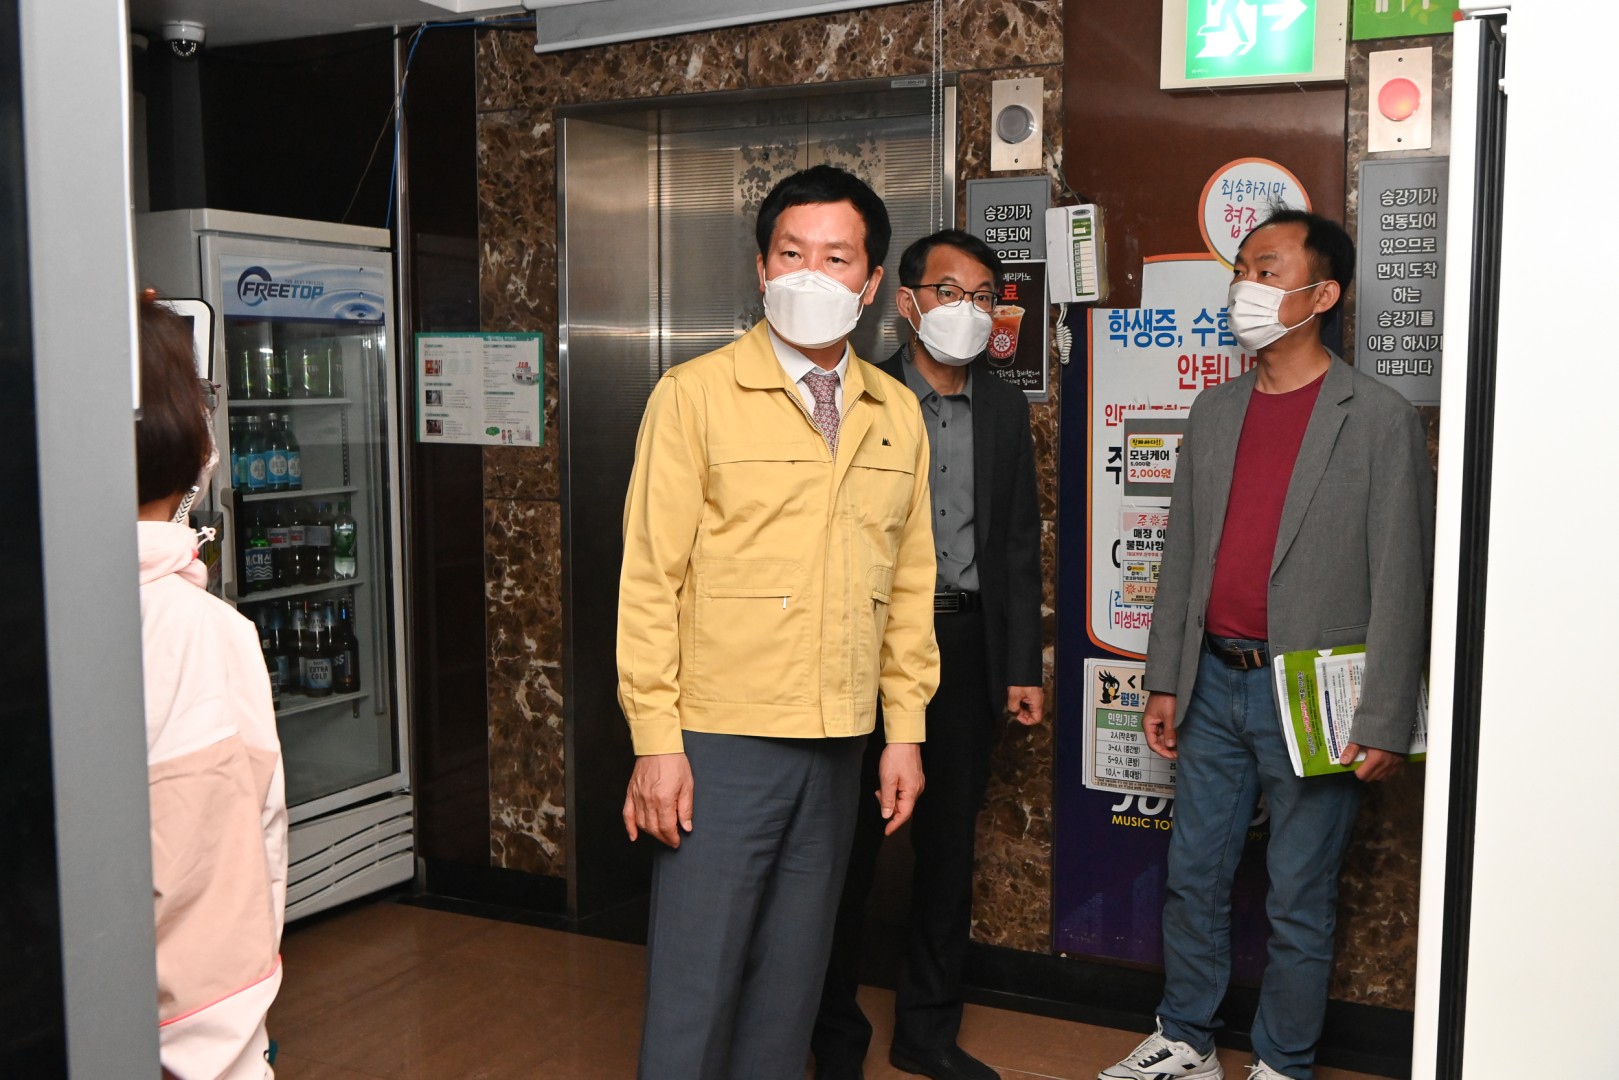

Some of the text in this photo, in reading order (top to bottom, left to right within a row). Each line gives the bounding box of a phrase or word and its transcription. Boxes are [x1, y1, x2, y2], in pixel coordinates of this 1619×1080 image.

[1222, 179, 1287, 203] 죄송하지만
[1381, 188, 1438, 206] 승강기가
[985, 204, 1032, 221] 승강기가
[1224, 204, 1257, 238] 협조
[1381, 212, 1437, 230] 연동되어
[985, 227, 1031, 242] 연동되어
[1380, 237, 1436, 254] 있으므로
[994, 249, 1030, 260] 으므로
[1378, 262, 1437, 279] 먼저 도착
[243, 281, 324, 301] FREETOP
[1001, 284, 1019, 300] 료
[1393, 287, 1421, 303] 하는
[1378, 311, 1434, 327] 승강기를
[1108, 308, 1183, 348] 학생증,
[1368, 334, 1443, 351] 이용 하시기
[1177, 353, 1257, 390] 안됩니
[1377, 359, 1433, 375] 바랍니다
[1130, 450, 1170, 461] 모닝케어
[1130, 468, 1172, 479] 2,000원
[1133, 528, 1153, 539] 매장
[1126, 540, 1164, 551] 불편사항
[1114, 611, 1154, 630] 미성년자
[1121, 692, 1139, 707] 평일
[1108, 712, 1138, 727] 인원기준
[1112, 815, 1174, 831] MUSIC TO
